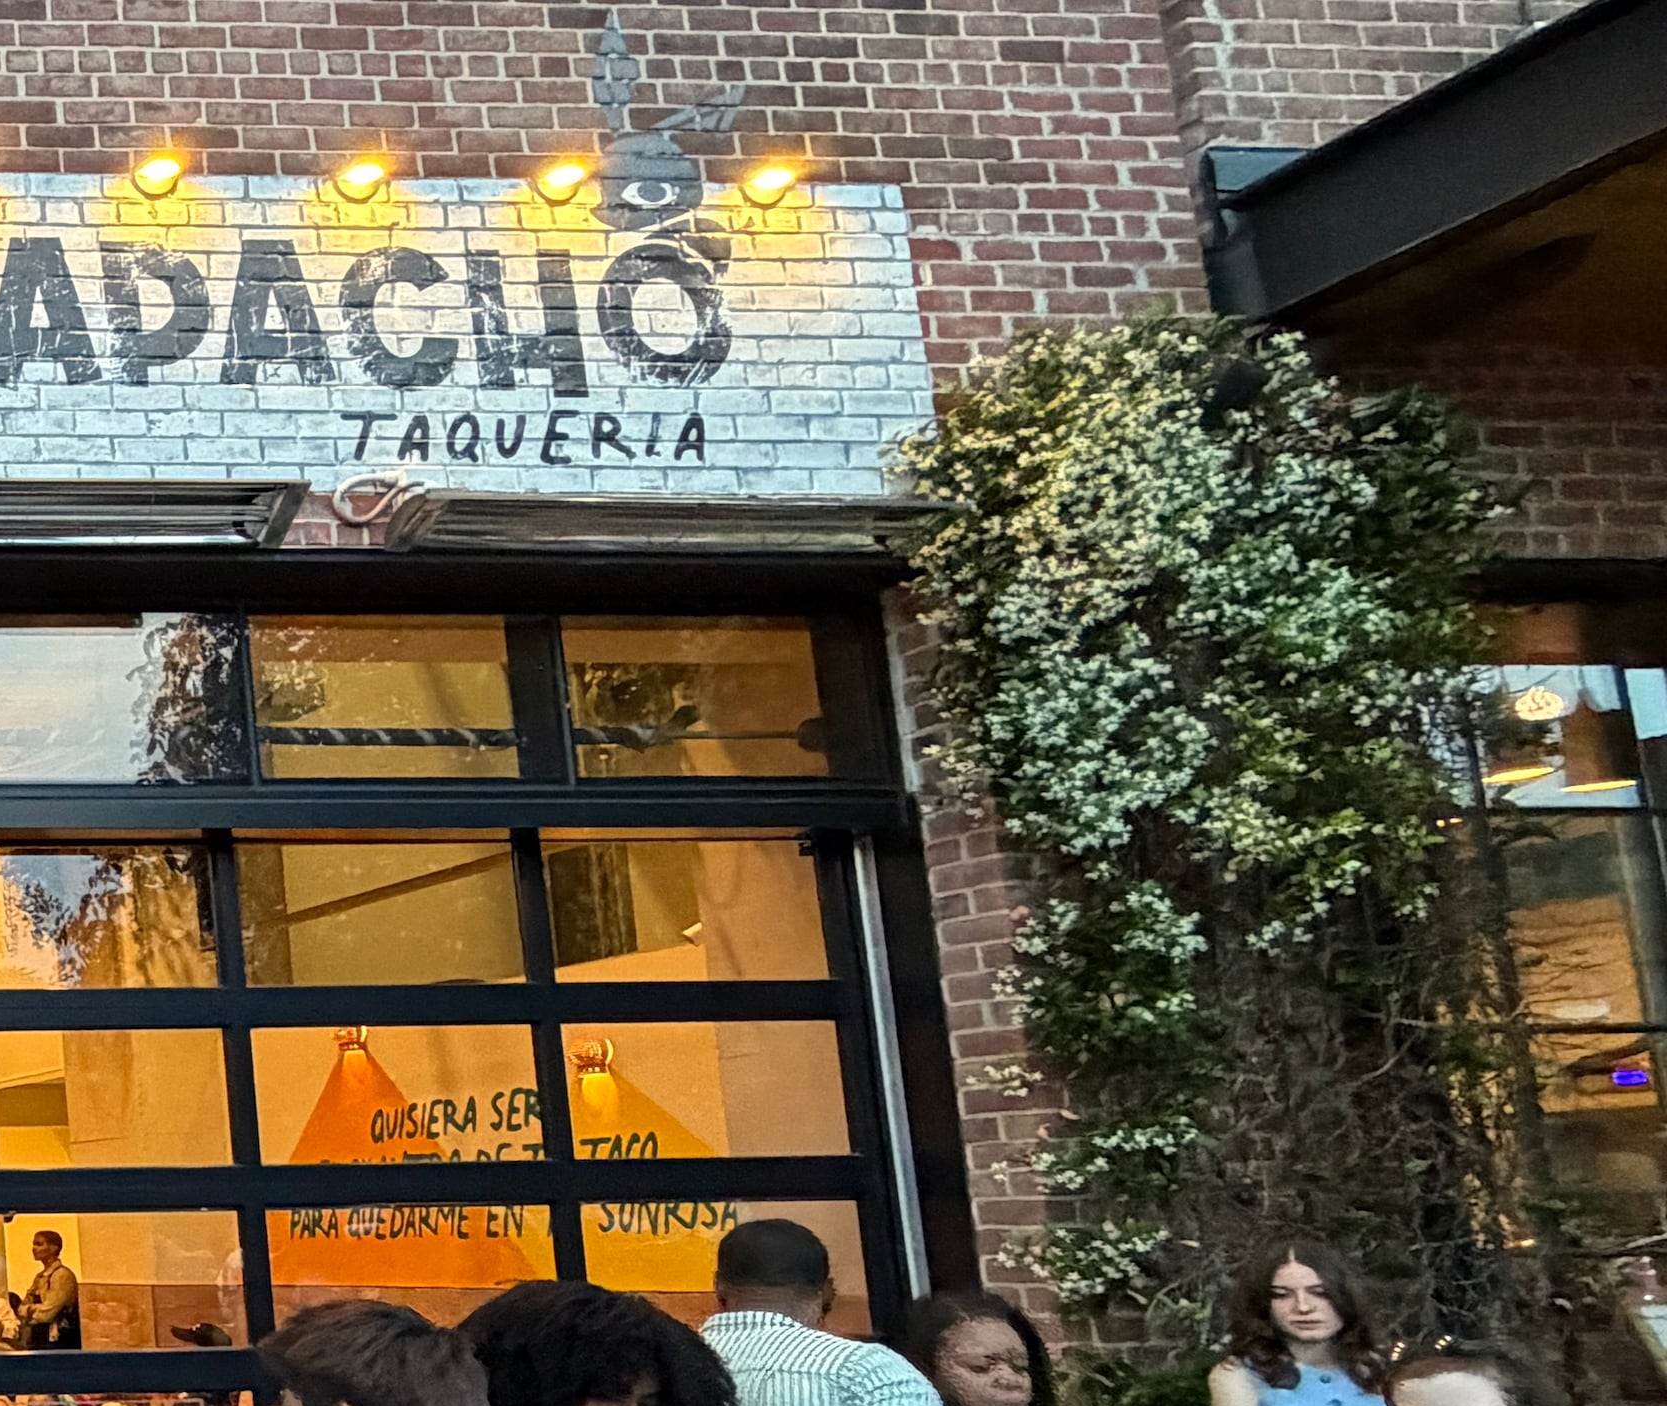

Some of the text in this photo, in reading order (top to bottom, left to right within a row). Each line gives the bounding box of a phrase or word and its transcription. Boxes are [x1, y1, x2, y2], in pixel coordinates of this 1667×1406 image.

[341, 410, 705, 464] TAQUERIA
[371, 1087, 543, 1143] QUISIERA SER
